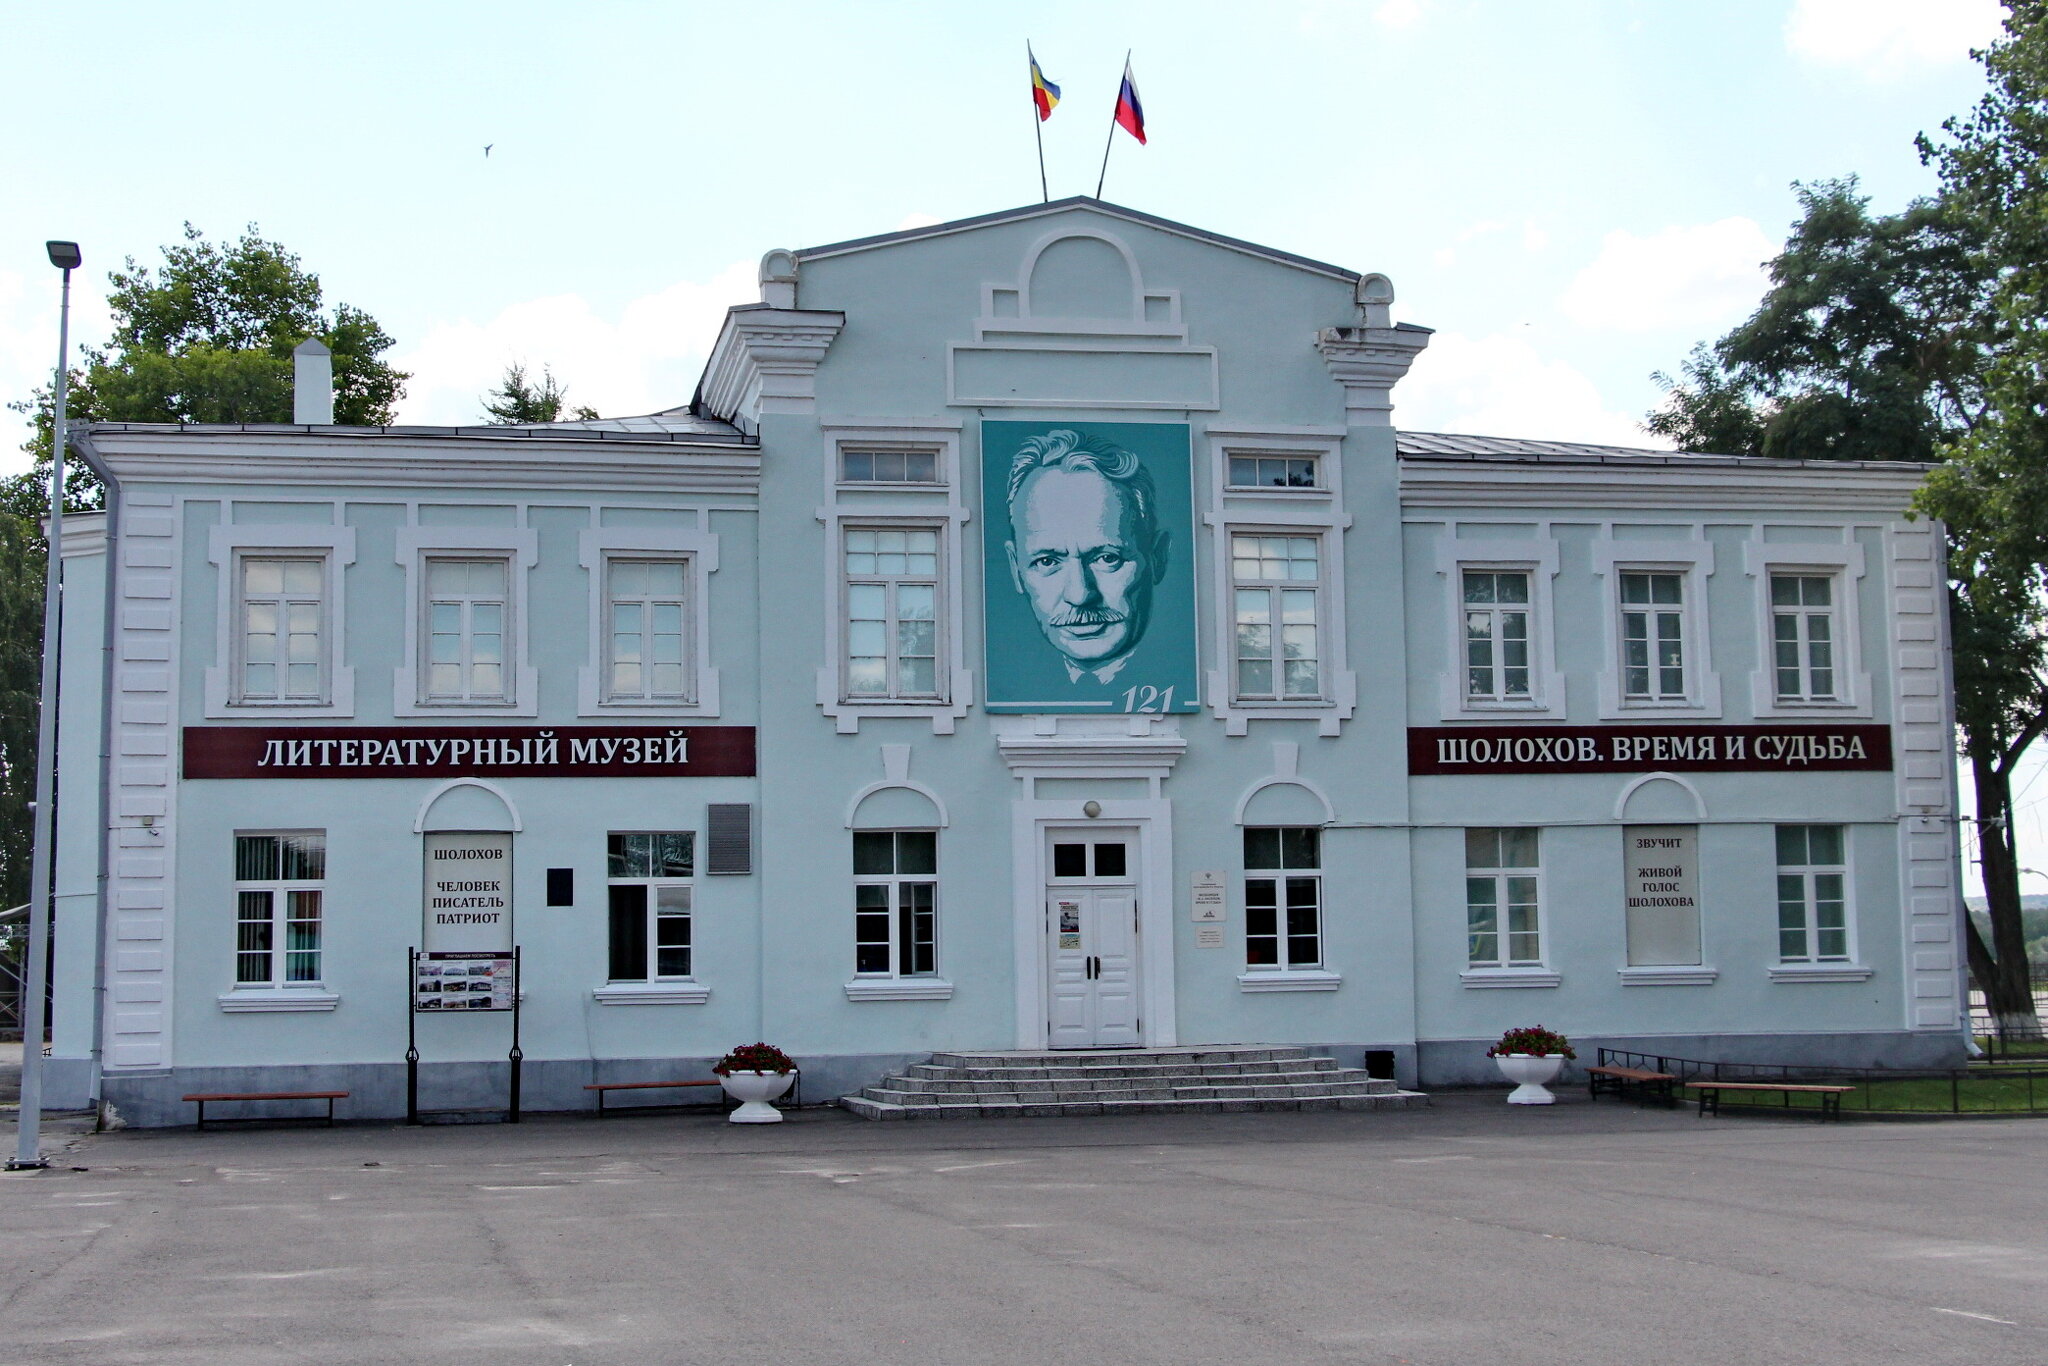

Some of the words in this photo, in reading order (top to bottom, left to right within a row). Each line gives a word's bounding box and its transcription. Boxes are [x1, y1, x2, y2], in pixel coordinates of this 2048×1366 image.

[1122, 685, 1174, 713] 121
[257, 731, 559, 766] ЛИТЕРАТУРНЫЙ
[569, 730, 689, 764] МУЗЕЙ
[1437, 737, 1604, 764] ШОЛОХОВ.
[1612, 736, 1716, 762] ВРЕМЯ
[1724, 736, 1745, 760] И
[1754, 735, 1867, 765] СУДЬБА
[1636, 838, 1682, 849] ЗВУЧИТ
[433, 849, 503, 860] ШОЛОХОВ
[1637, 865, 1682, 878] ЖИВОЙ
[436, 881, 501, 892] ЧЕЛОВЕК
[1642, 882, 1680, 893] ГОЛОС
[432, 897, 504, 908] ПИСАТЕЛЬ
[1628, 897, 1695, 908] ШОЛОХОВА
[436, 913, 501, 924] ПАТРИОТ
